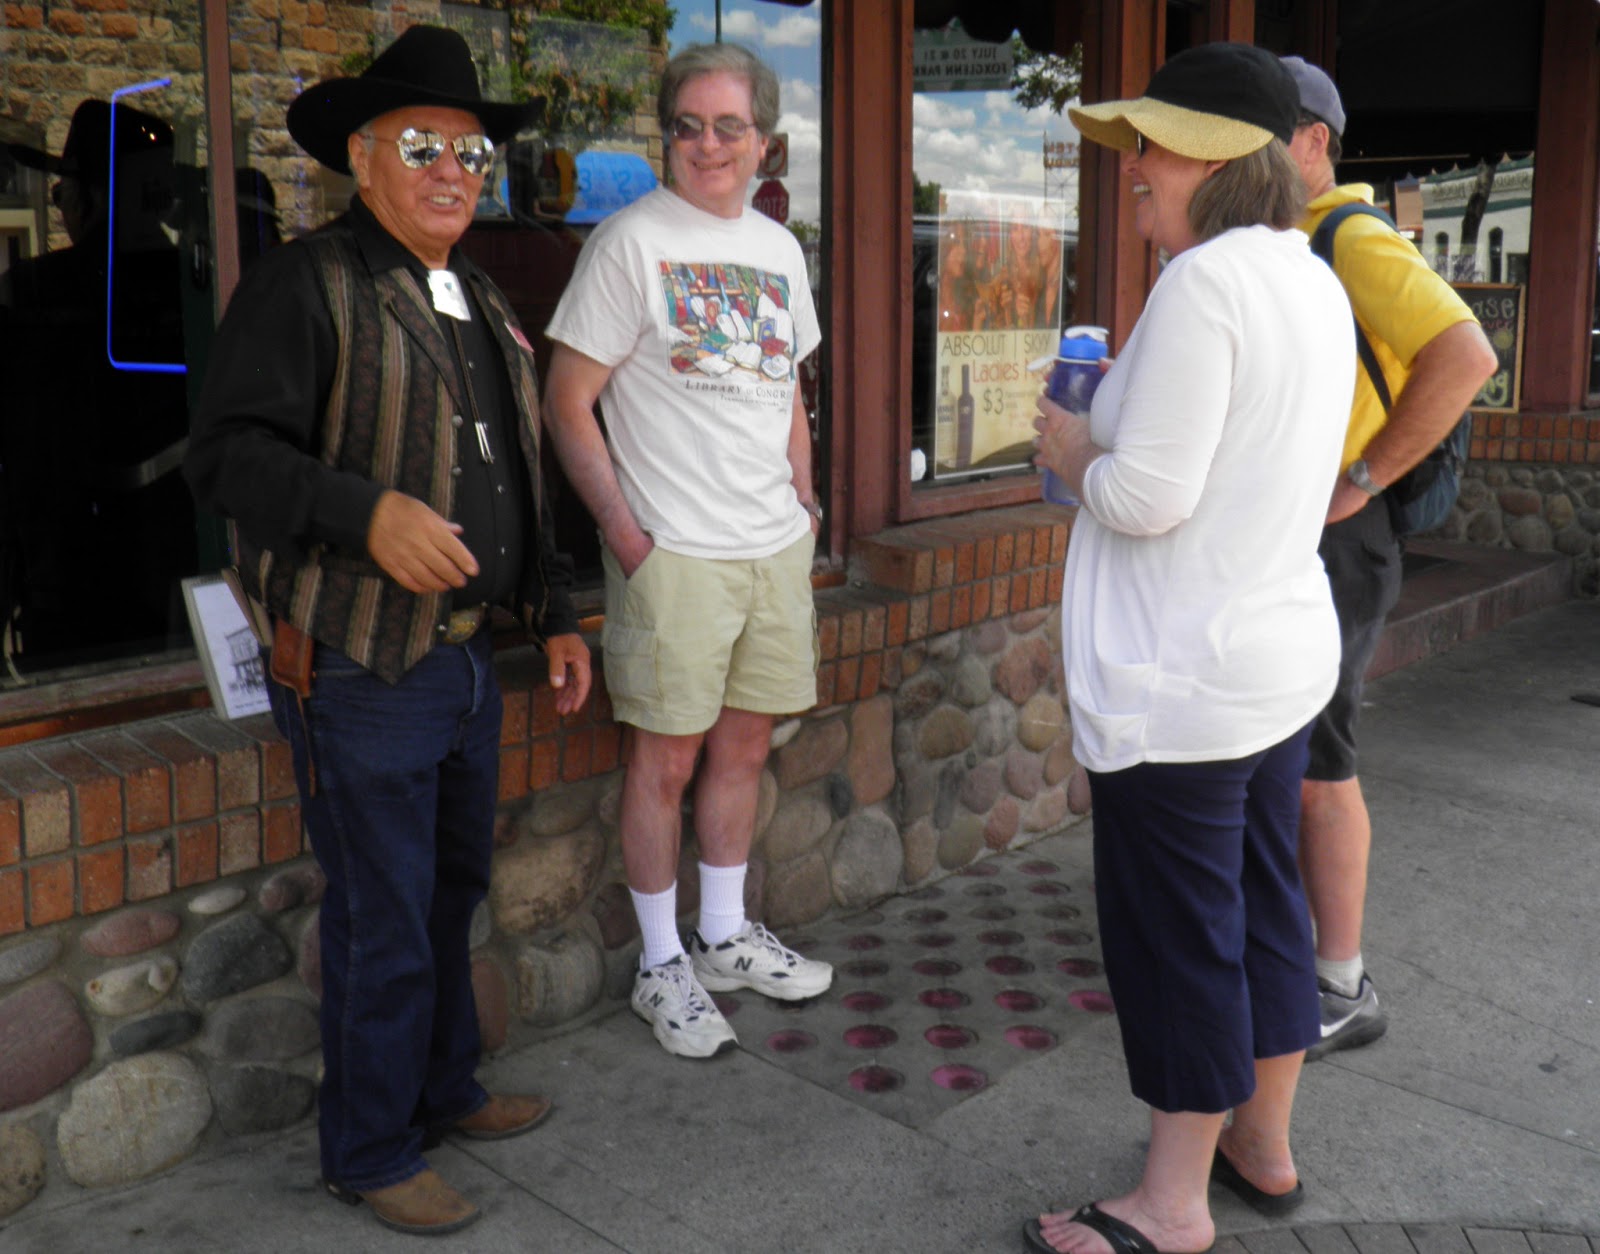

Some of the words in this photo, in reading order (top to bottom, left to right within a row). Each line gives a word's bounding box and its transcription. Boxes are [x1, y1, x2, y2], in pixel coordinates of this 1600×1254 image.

[941, 334, 1006, 357] ABSOLUT
[972, 359, 1020, 384] Ladies
[685, 379, 741, 395] LIBRARY
[983, 387, 1005, 416] $3
